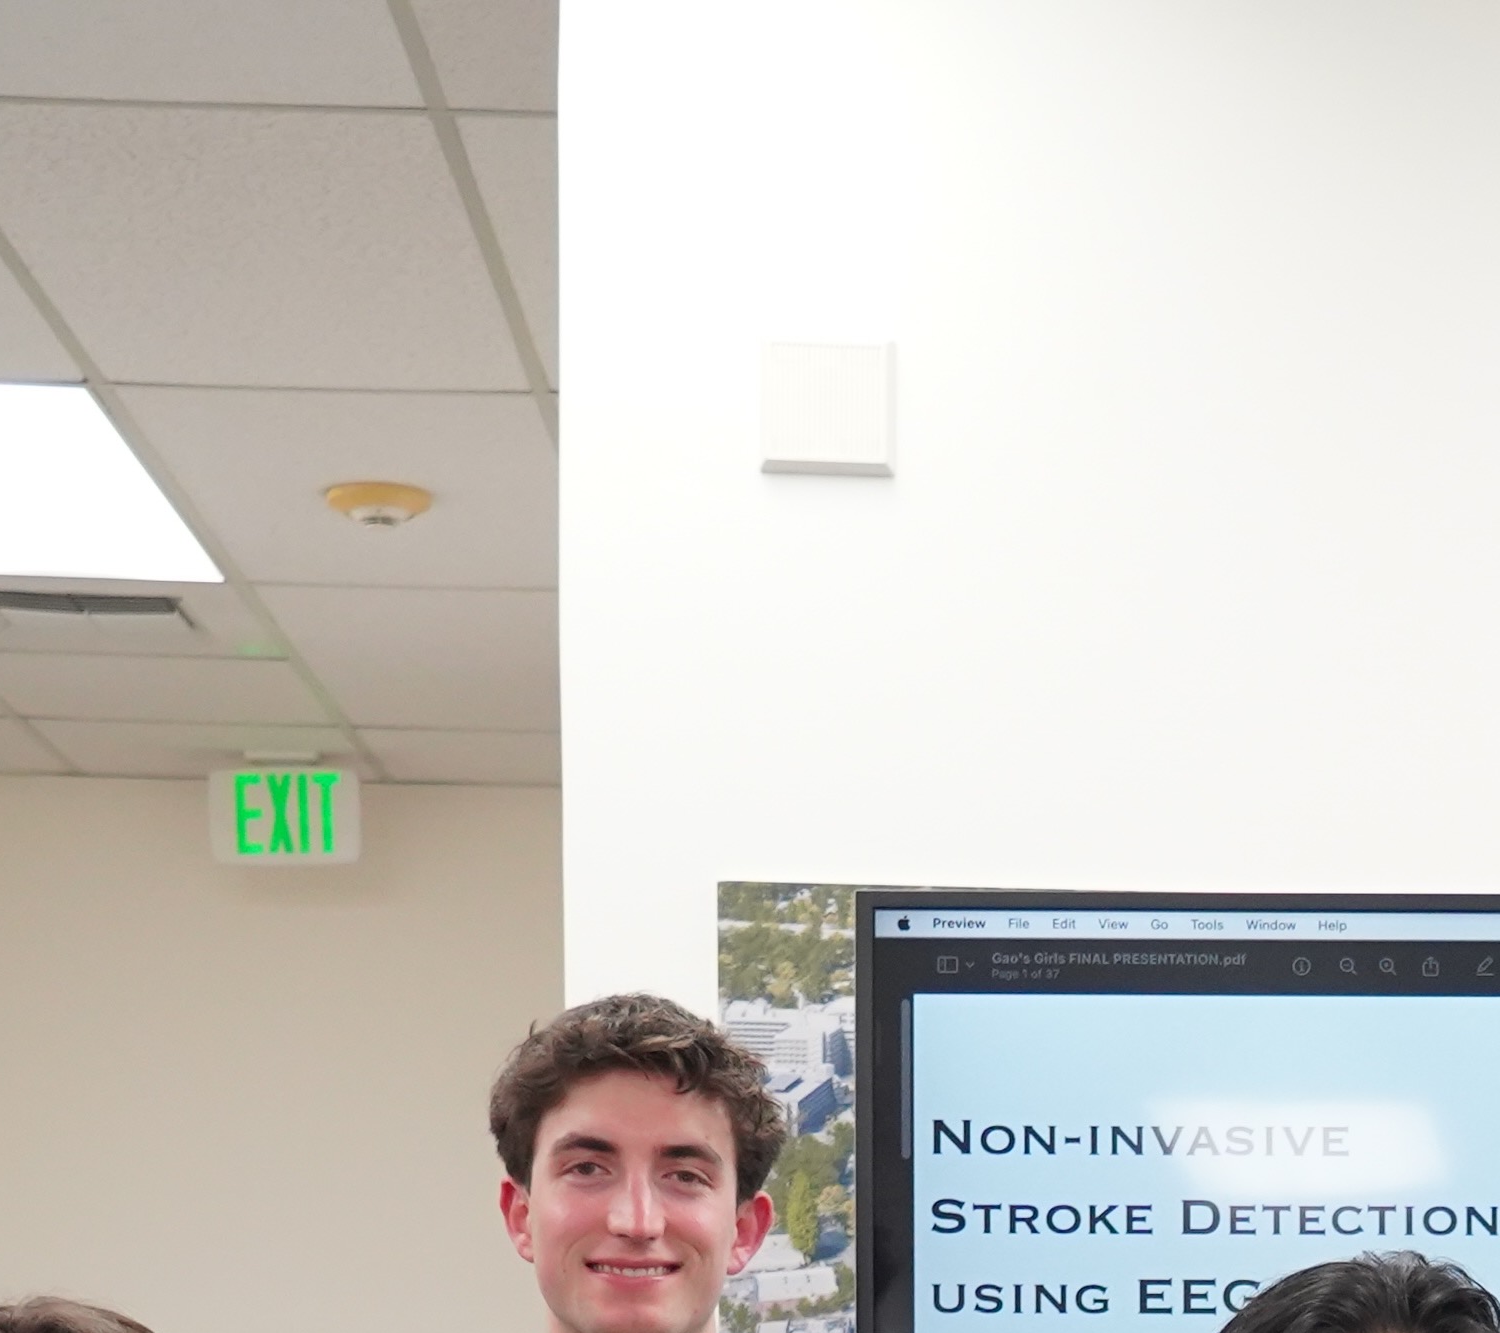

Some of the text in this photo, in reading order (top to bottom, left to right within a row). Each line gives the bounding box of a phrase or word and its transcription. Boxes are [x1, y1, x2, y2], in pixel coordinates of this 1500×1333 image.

[235, 773, 341, 854] EXIT
[932, 917, 1348, 933] Preview File Edit View Go Tools Window Help
[991, 952, 1247, 968] Gao's Girls FINAL PRESENTATION.pdf
[991, 969, 1020, 981] Page
[1031, 968, 1043, 979] of
[931, 1198, 1500, 1237] STROKE DETECTION
[932, 1278, 1261, 1315] USING EEG
